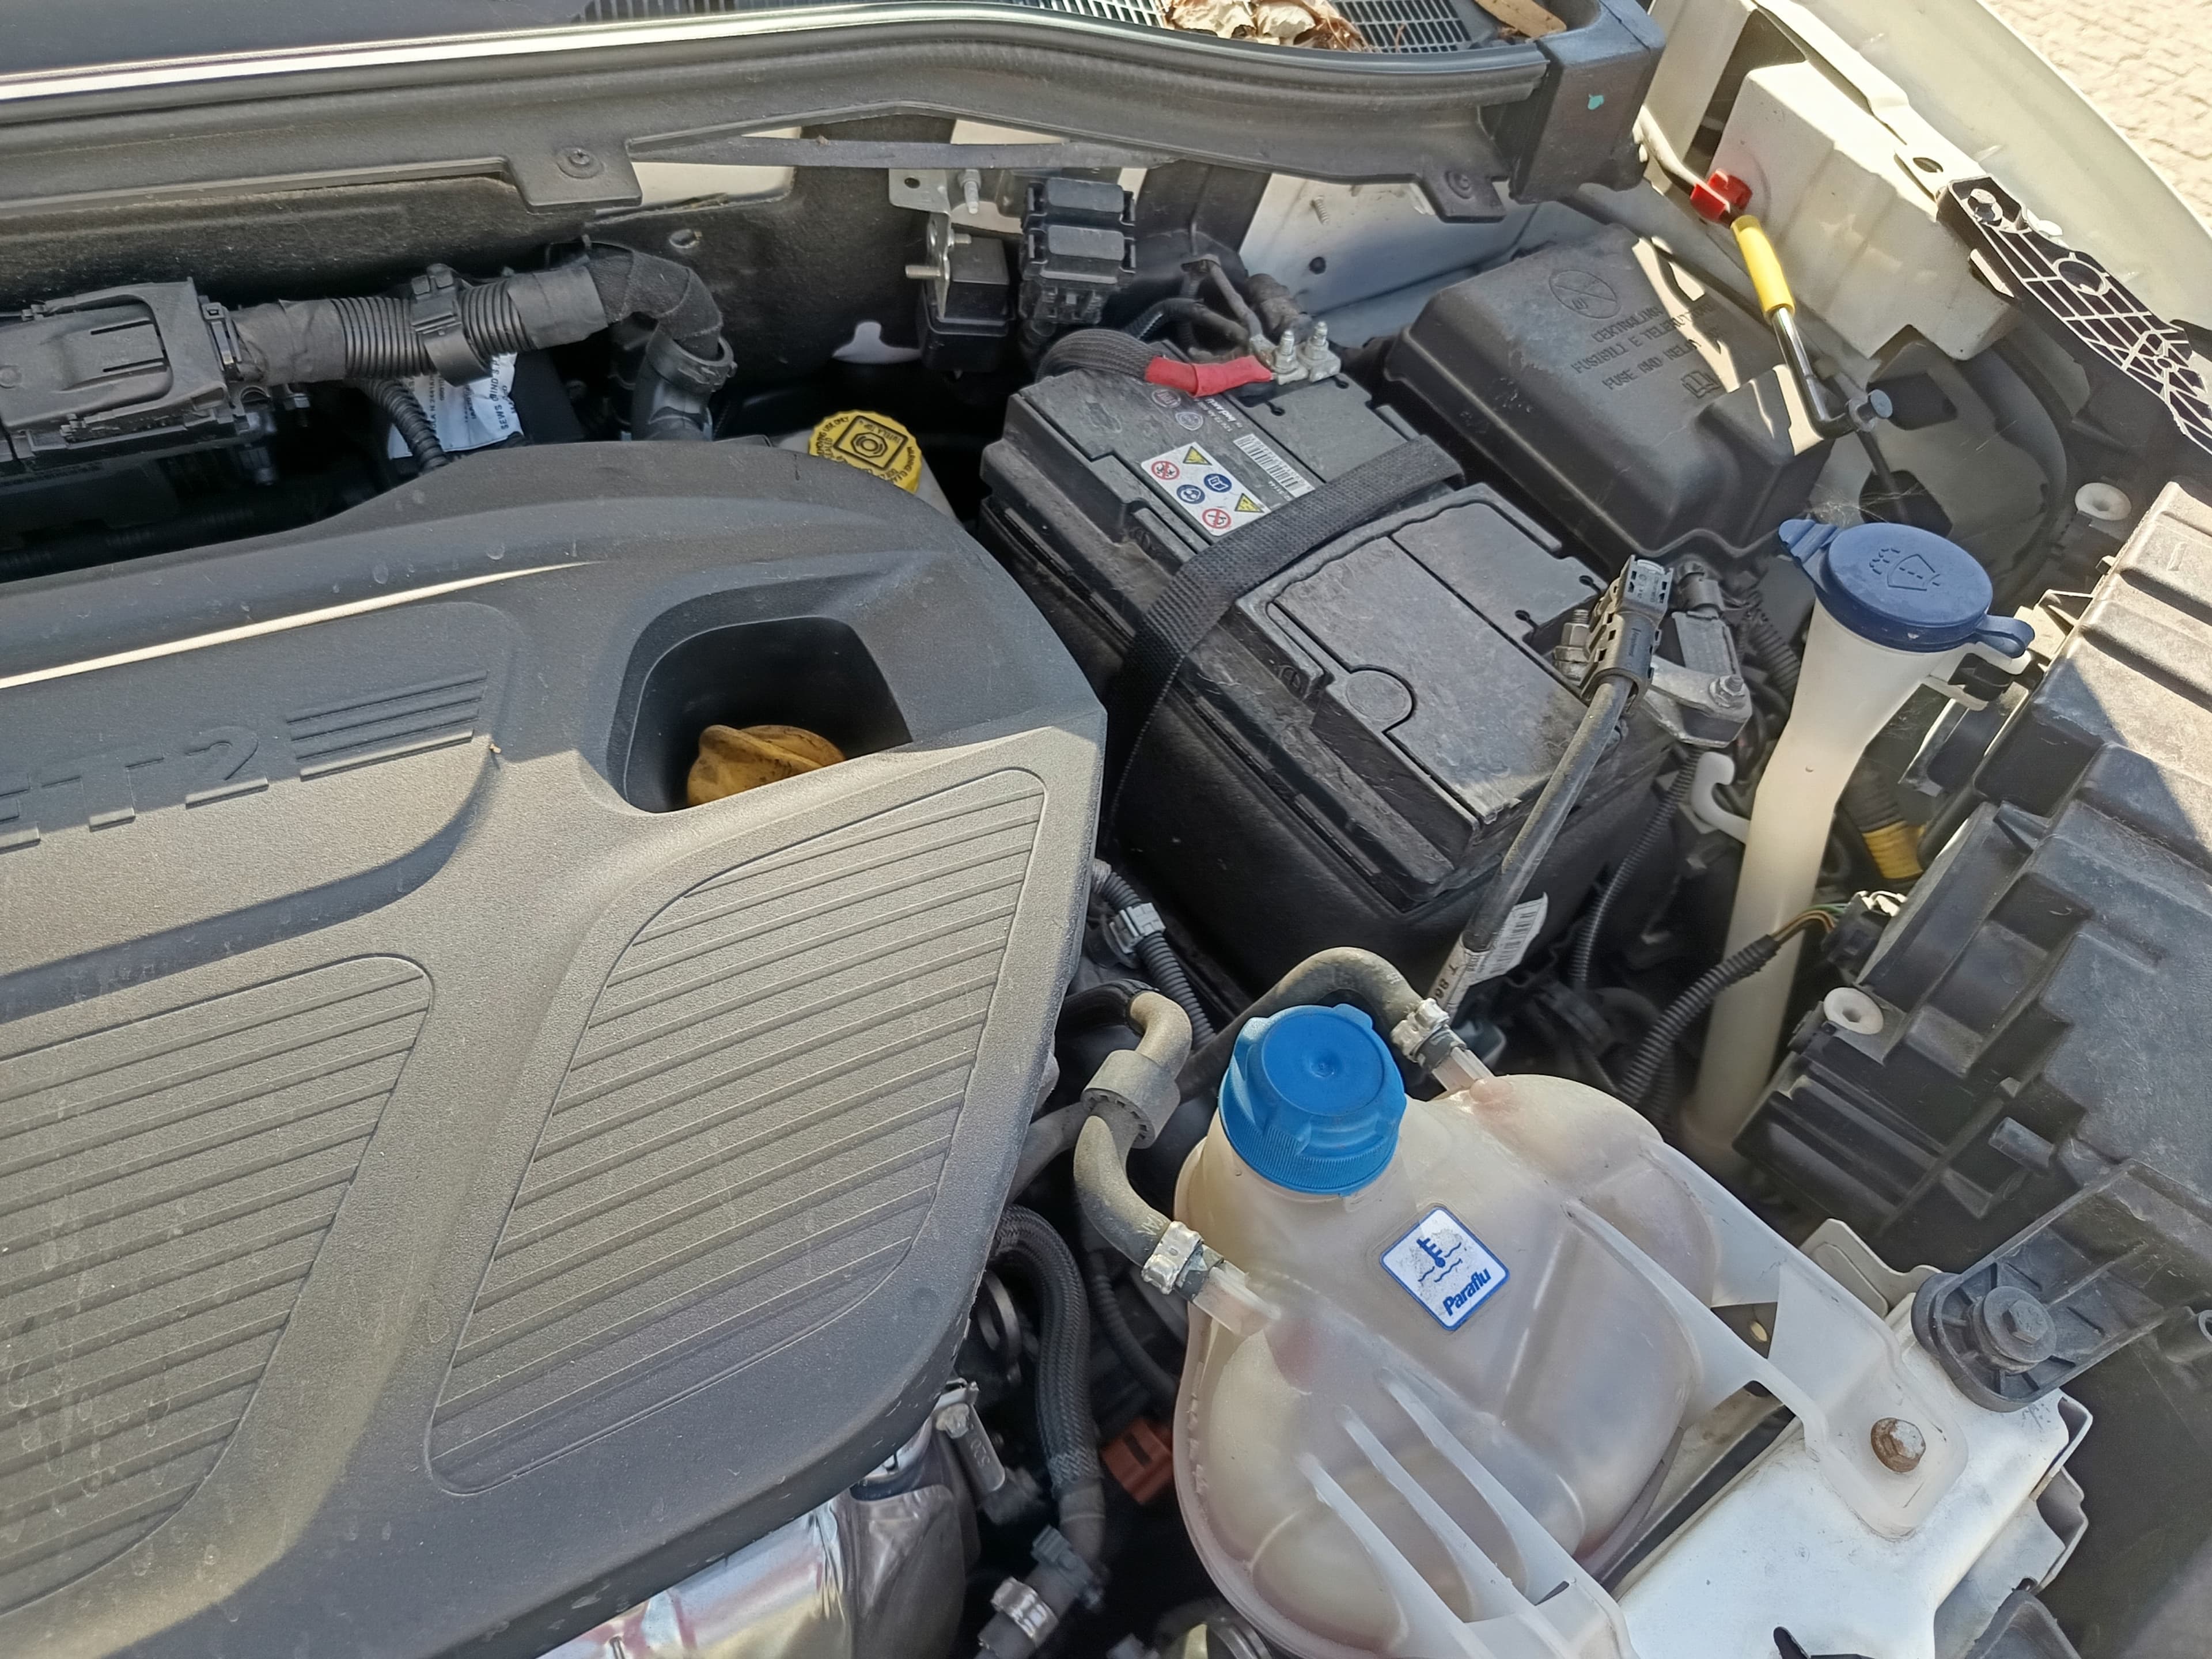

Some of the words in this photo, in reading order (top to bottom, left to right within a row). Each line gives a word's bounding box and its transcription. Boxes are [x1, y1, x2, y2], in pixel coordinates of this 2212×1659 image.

[1591, 306, 1664, 343] CENTRALINA
[1571, 343, 1628, 374] FUSIBILI
[1630, 336, 1641, 348] E
[1603, 368, 1639, 391] FUSE
[1638, 355, 1662, 374] AND
[494, 404, 509, 429] SEWS
[1442, 1268, 1491, 1316] Paraflu
